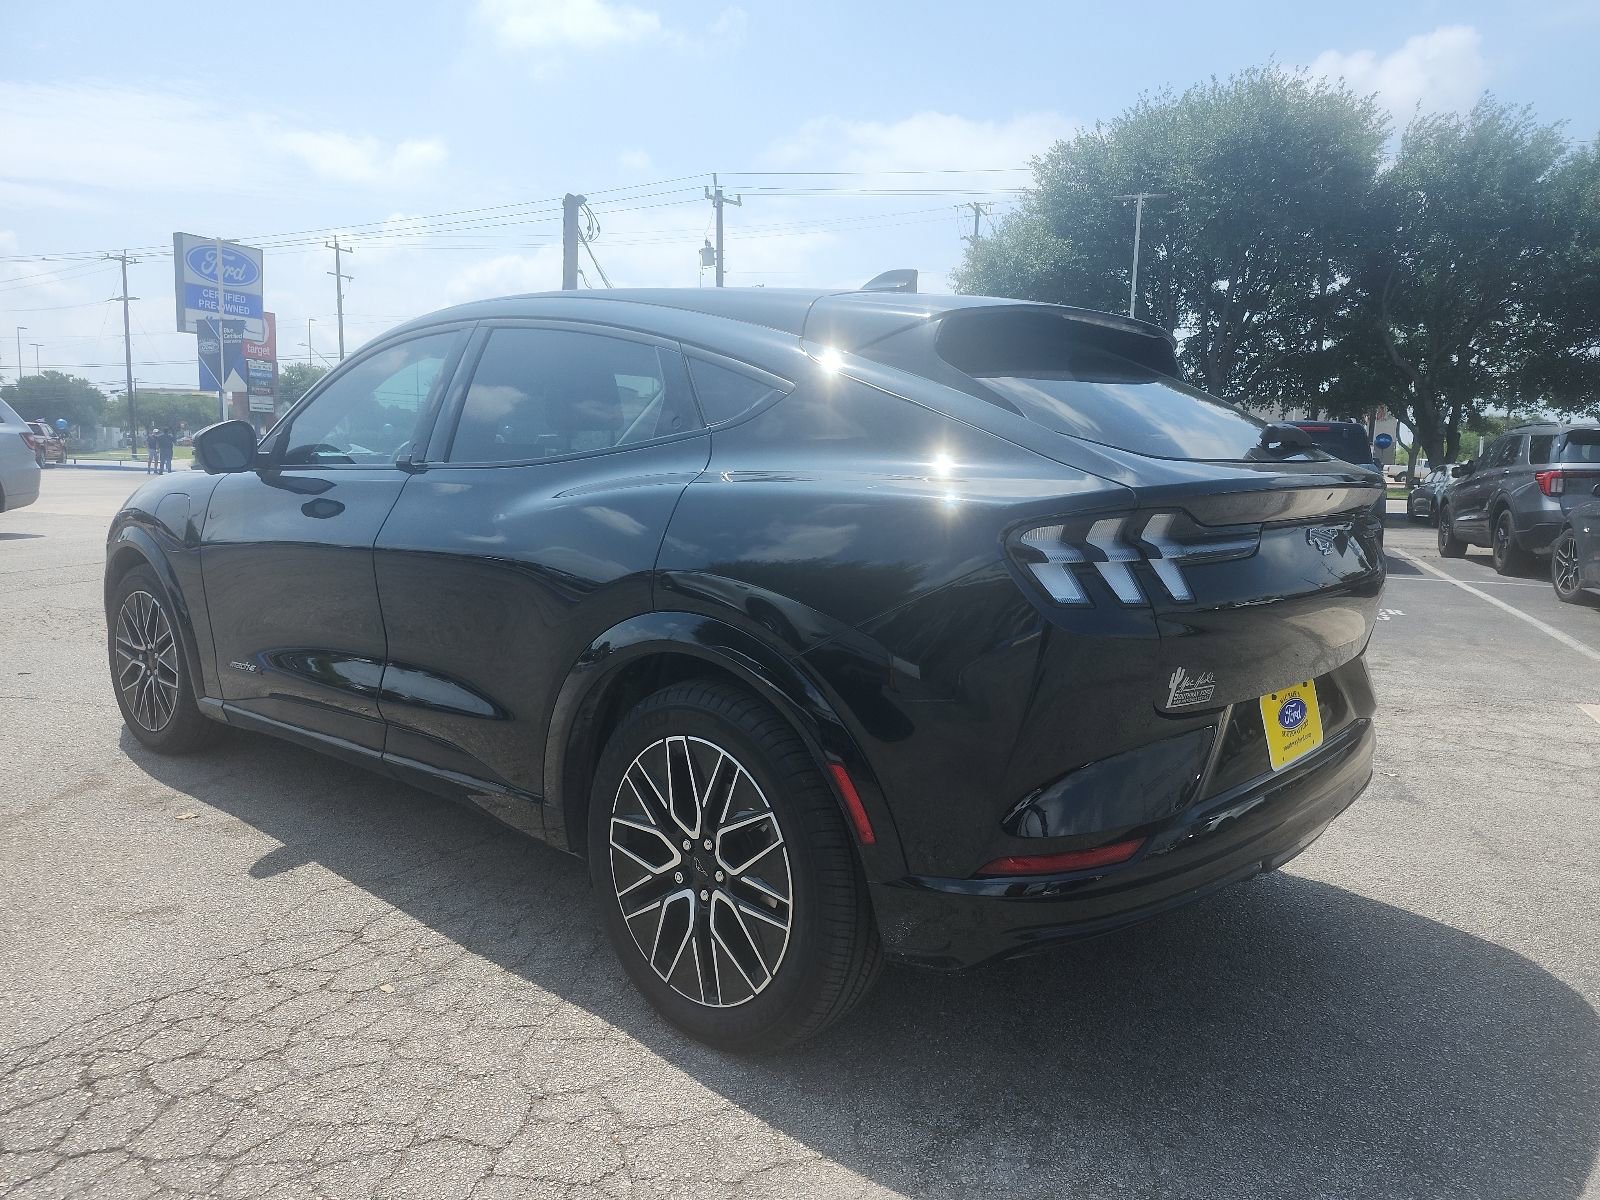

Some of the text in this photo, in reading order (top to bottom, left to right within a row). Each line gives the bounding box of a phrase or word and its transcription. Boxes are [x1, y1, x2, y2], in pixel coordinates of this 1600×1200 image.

[201, 250, 246, 281] Frd
[203, 289, 246, 303] CERIFIED
[247, 344, 271, 356] target
[1284, 702, 1302, 725] Ford
